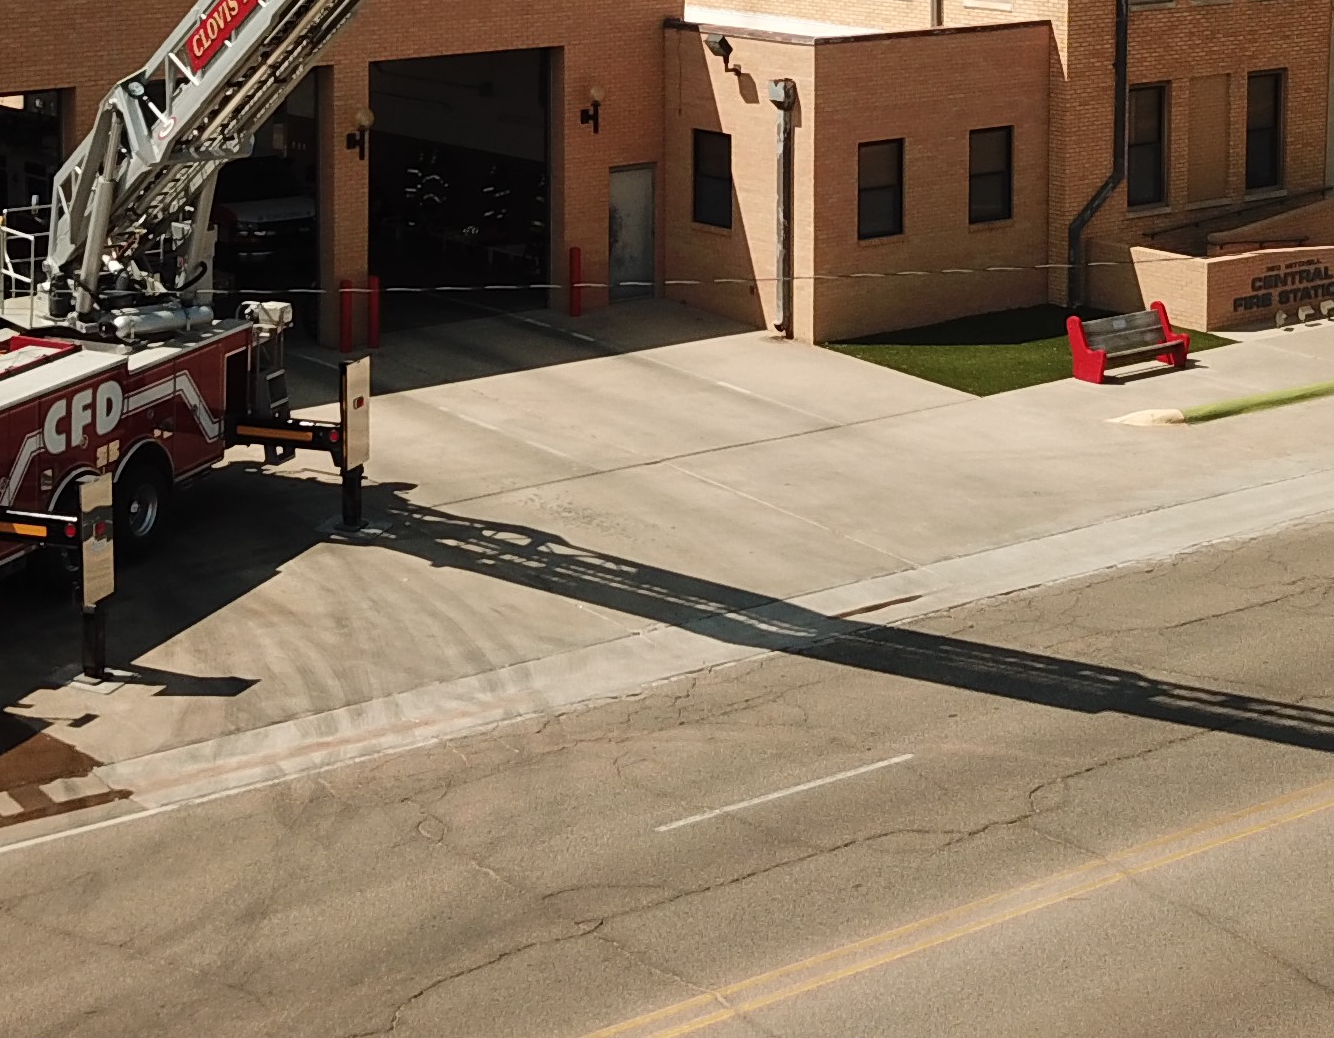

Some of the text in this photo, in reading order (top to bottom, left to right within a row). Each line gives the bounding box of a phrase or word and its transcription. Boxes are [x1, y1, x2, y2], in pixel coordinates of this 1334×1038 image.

[1251, 266, 1334, 291] CENTRAL
[1233, 292, 1272, 312] FIRE
[44, 380, 123, 455] CFD
